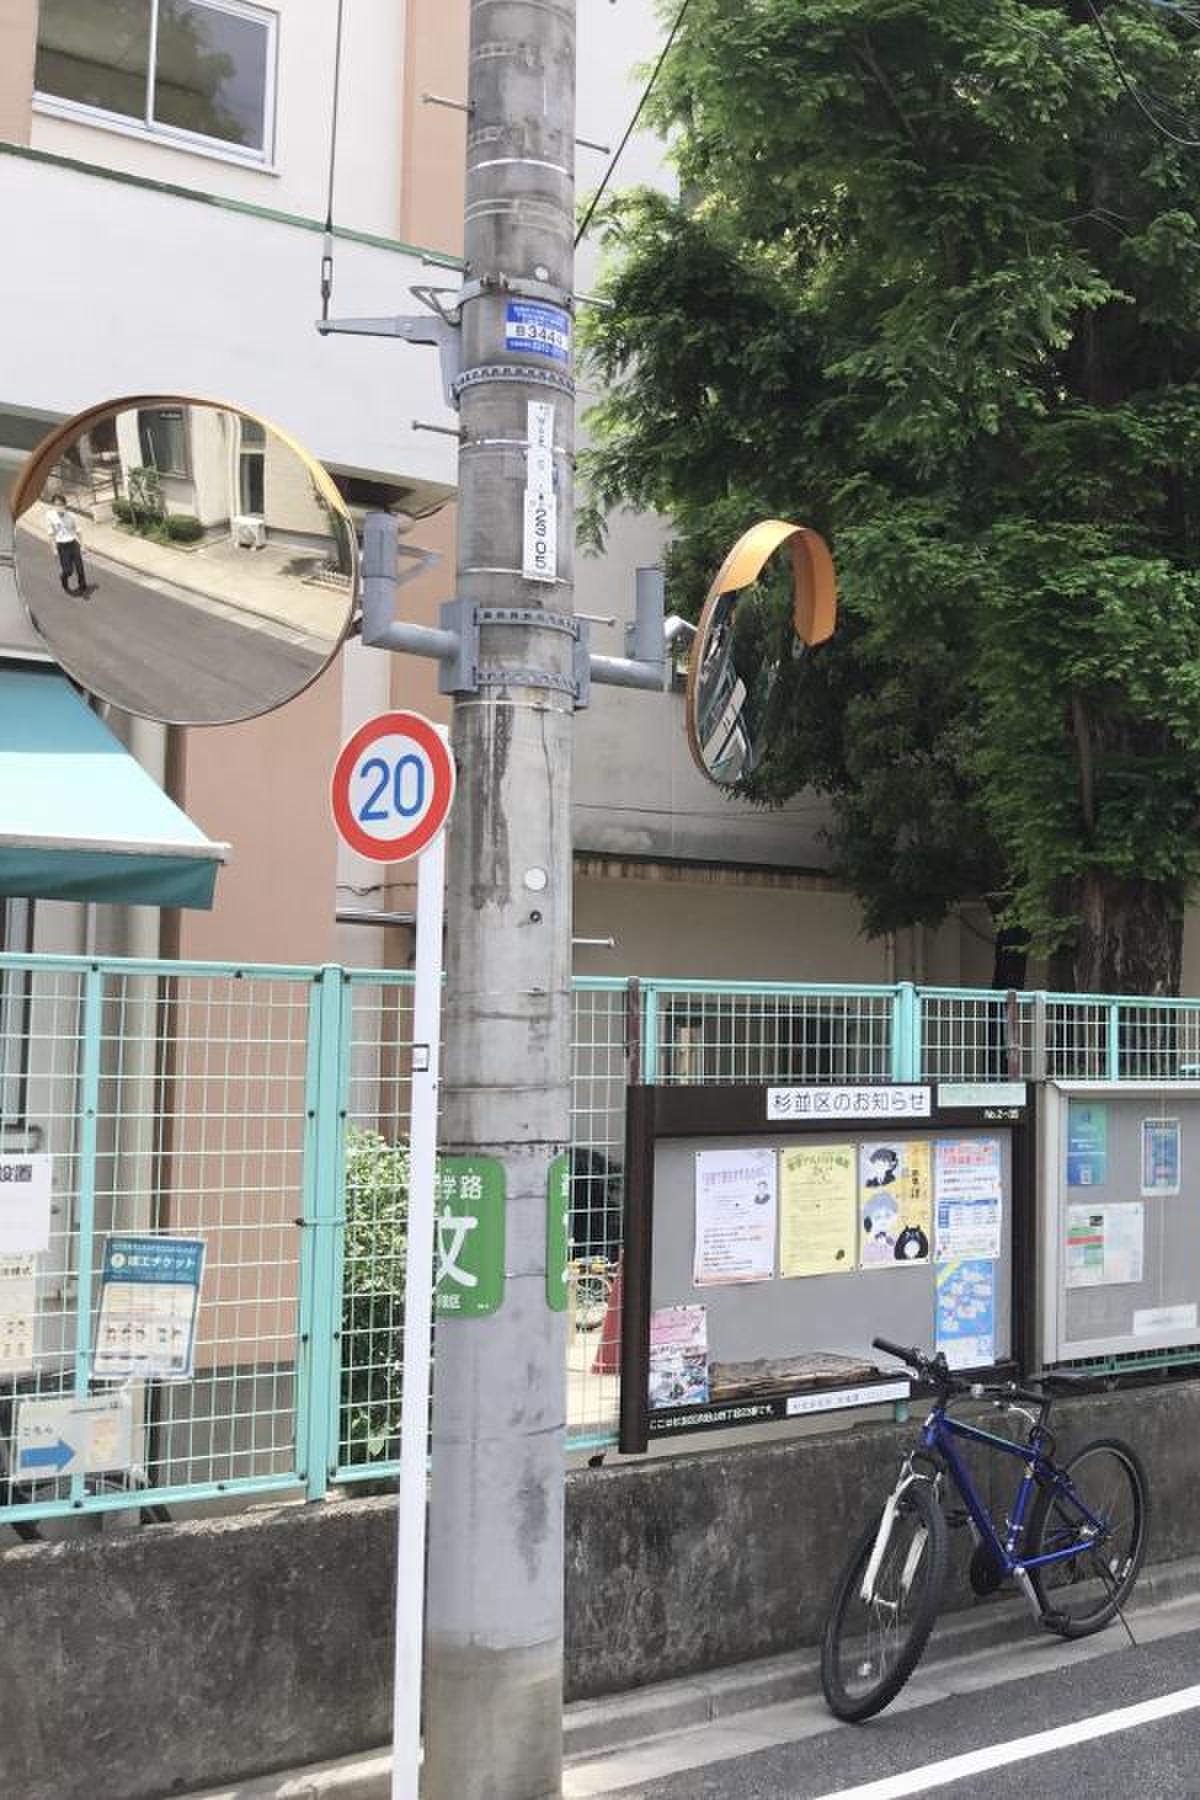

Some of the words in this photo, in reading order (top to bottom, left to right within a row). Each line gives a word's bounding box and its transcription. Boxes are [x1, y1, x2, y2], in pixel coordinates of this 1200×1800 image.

[359, 754, 425, 822] 20
[772, 1091, 927, 1113] 杉並区のお知らせ
[434, 1174, 483, 1200] 学路
